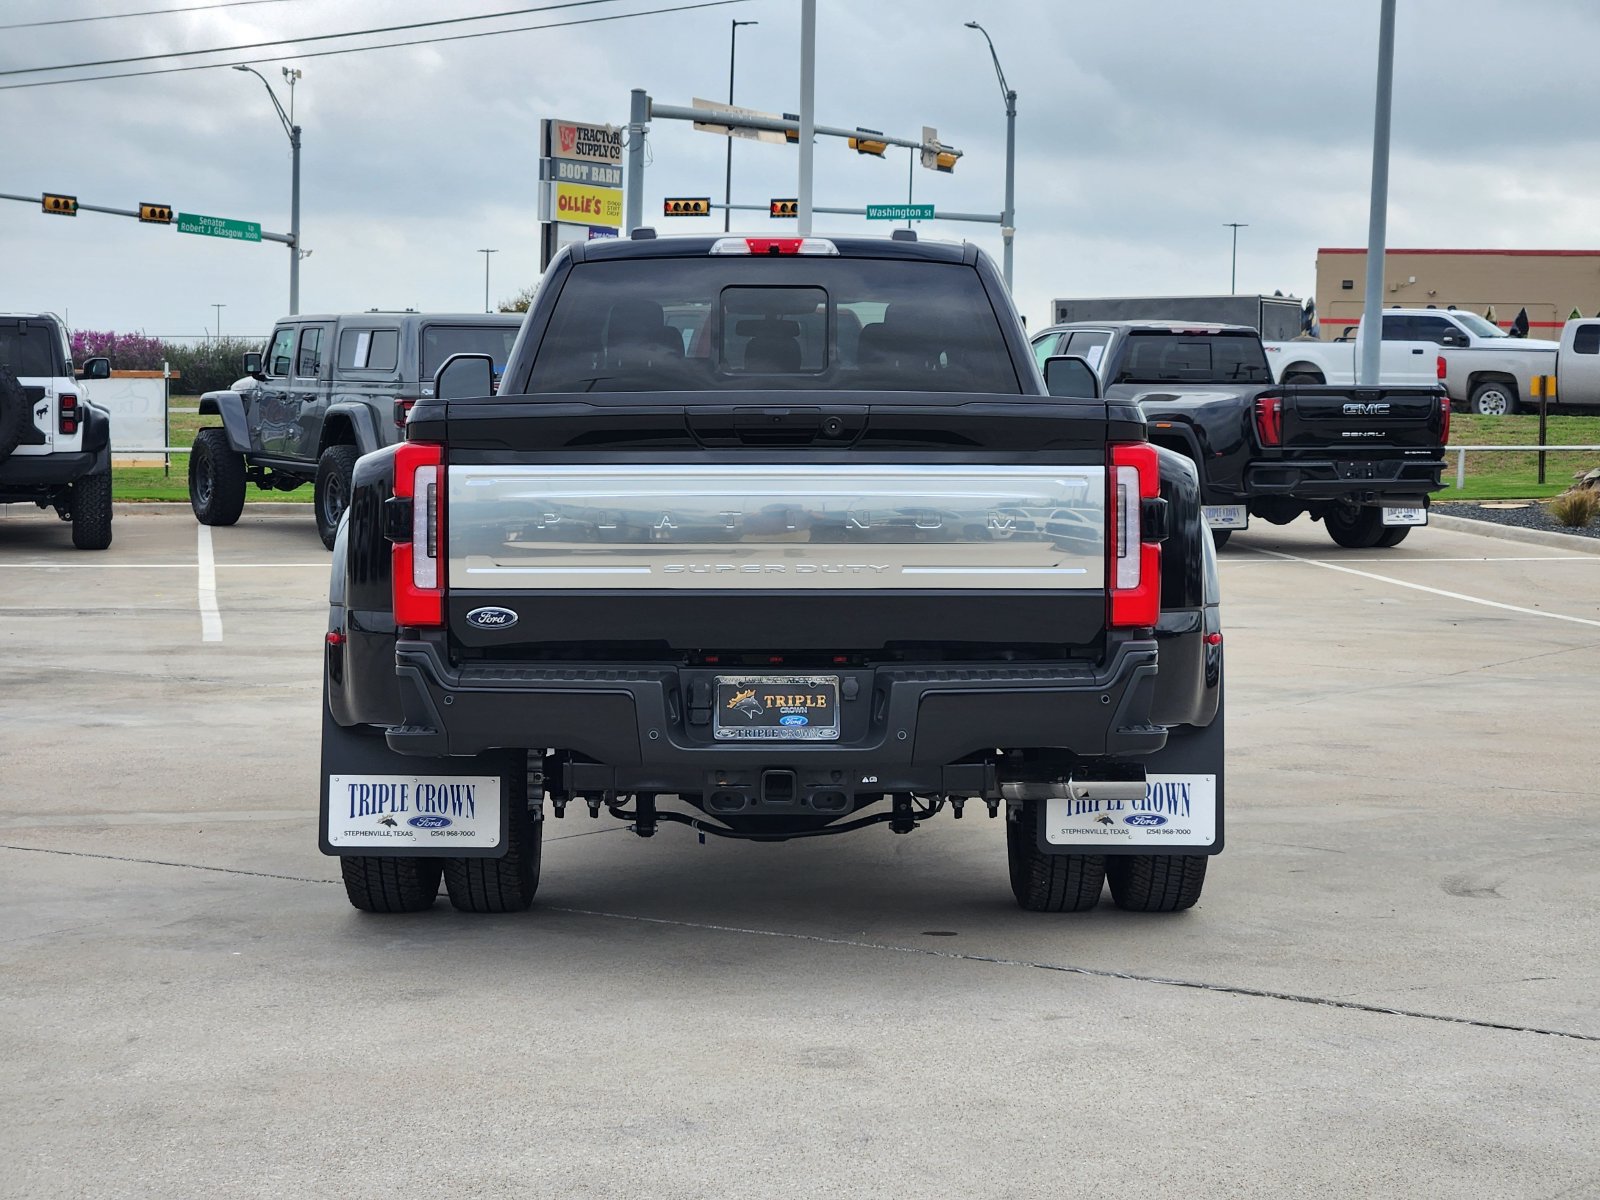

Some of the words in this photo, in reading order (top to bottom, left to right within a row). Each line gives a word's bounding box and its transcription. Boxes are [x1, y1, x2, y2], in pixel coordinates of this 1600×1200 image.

[576, 127, 620, 145] TRACTOR
[576, 142, 610, 157] SUPPLY
[559, 162, 589, 180] BOOT
[591, 166, 621, 184] BARN
[869, 207, 921, 219] Washington
[199, 216, 226, 227] Senator
[180, 222, 205, 233] Robert
[207, 226, 211, 234] J
[213, 226, 243, 239] Glasgow
[1342, 403, 1391, 415] GMC
[535, 510, 1017, 529] PLATINUM
[663, 563, 785, 574] SUPER
[795, 563, 889, 574] DUTY
[477, 611, 506, 625] Ford
[764, 695, 827, 708] TRIPLE
[779, 706, 808, 714] CROWN
[736, 729, 778, 738] TRIPLE
[780, 728, 819, 738] CROWN
[348, 783, 409, 819] TRIPLE
[415, 783, 476, 819] CROWN
[343, 830, 393, 838] STEPHENVILLE,
[1061, 828, 1109, 836] STEPHENVILLE,
